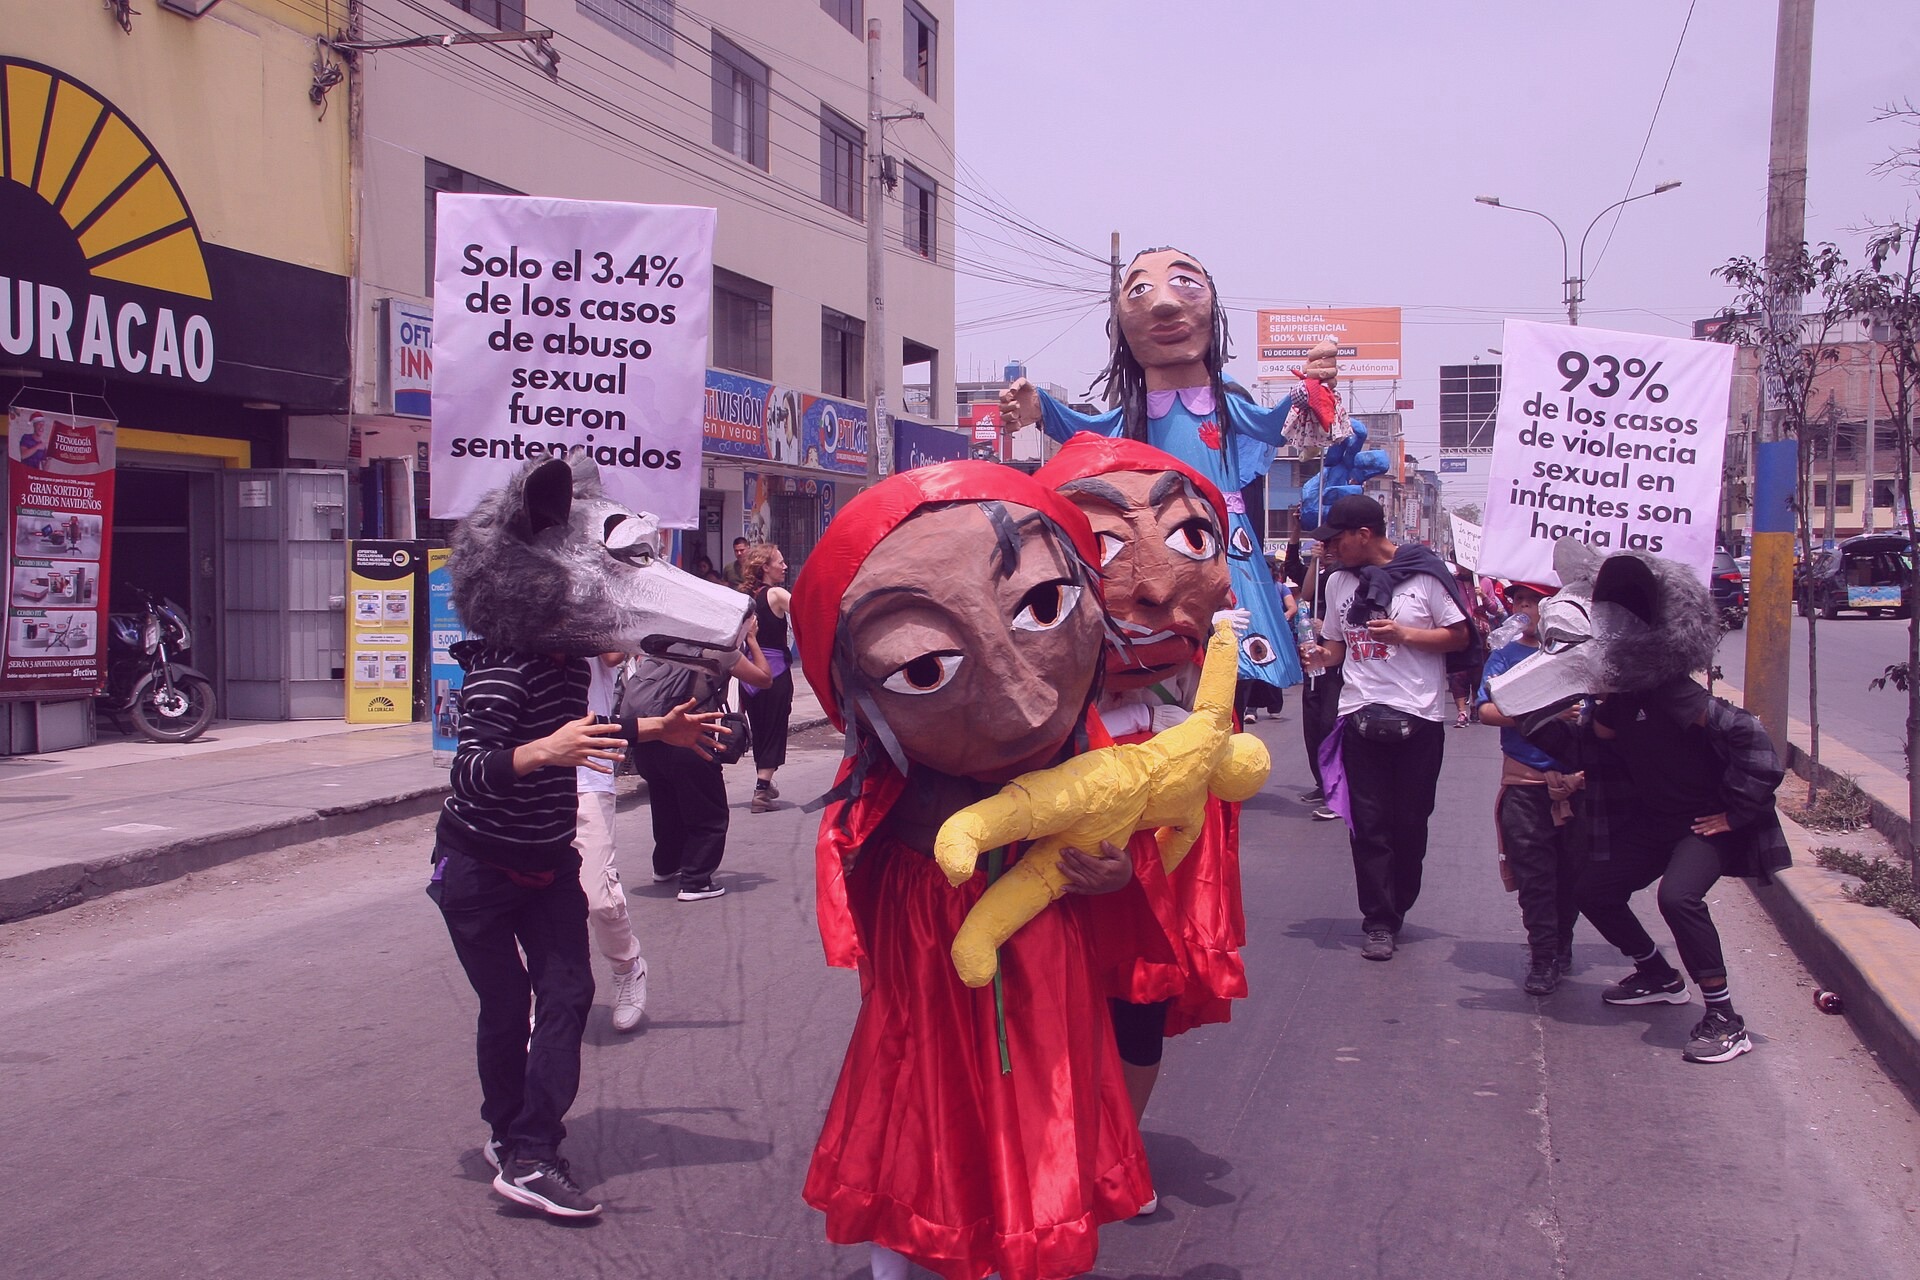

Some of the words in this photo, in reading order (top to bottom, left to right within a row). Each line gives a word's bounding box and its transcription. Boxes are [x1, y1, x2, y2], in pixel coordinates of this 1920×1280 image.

[461, 244, 543, 280] Solo
[551, 249, 582, 282] el
[591, 251, 684, 289] 3.4%
[466, 281, 512, 315] de
[522, 283, 571, 318] los
[580, 299, 676, 325] casos
[1269, 315, 1325, 323] PRESENCIAL
[1269, 324, 1347, 333] SEMIPRESENCIAL
[400, 322, 433, 349] OFT
[488, 319, 534, 353] de
[542, 323, 652, 360] abuso
[1269, 334, 1295, 342] 100%
[1263, 348, 1273, 357] TÚ
[511, 363, 627, 395] sexual
[1350, 363, 1394, 372] Autónoma
[1557, 350, 1669, 404] 93%
[508, 391, 626, 431] fueron
[703, 387, 763, 430] TIVISIÓN
[1522, 391, 1559, 420] de
[1566, 396, 1607, 428] los
[1613, 413, 1698, 436] casos
[56, 434, 91, 446] TECNOLOGÍA
[720, 425, 726, 439] y
[729, 426, 757, 441] veras
[1518, 420, 1555, 449] de
[1562, 429, 1696, 465] violencia
[60, 444, 92, 454] COMODIDAD
[30, 482, 52, 495] GRAN
[53, 485, 82, 498] SORTEO
[83, 487, 94, 498] DE
[1532, 461, 1630, 489] sexual
[1637, 474, 1675, 493] en
[21, 494, 26, 505] 3
[27, 494, 60, 507] COMBOS
[60, 497, 102, 511] NAVIDEÑOS
[1510, 478, 1629, 519] infantes
[1637, 504, 1692, 525] son
[1619, 522, 1664, 553] las
[438, 635, 459, 647] 5,000
